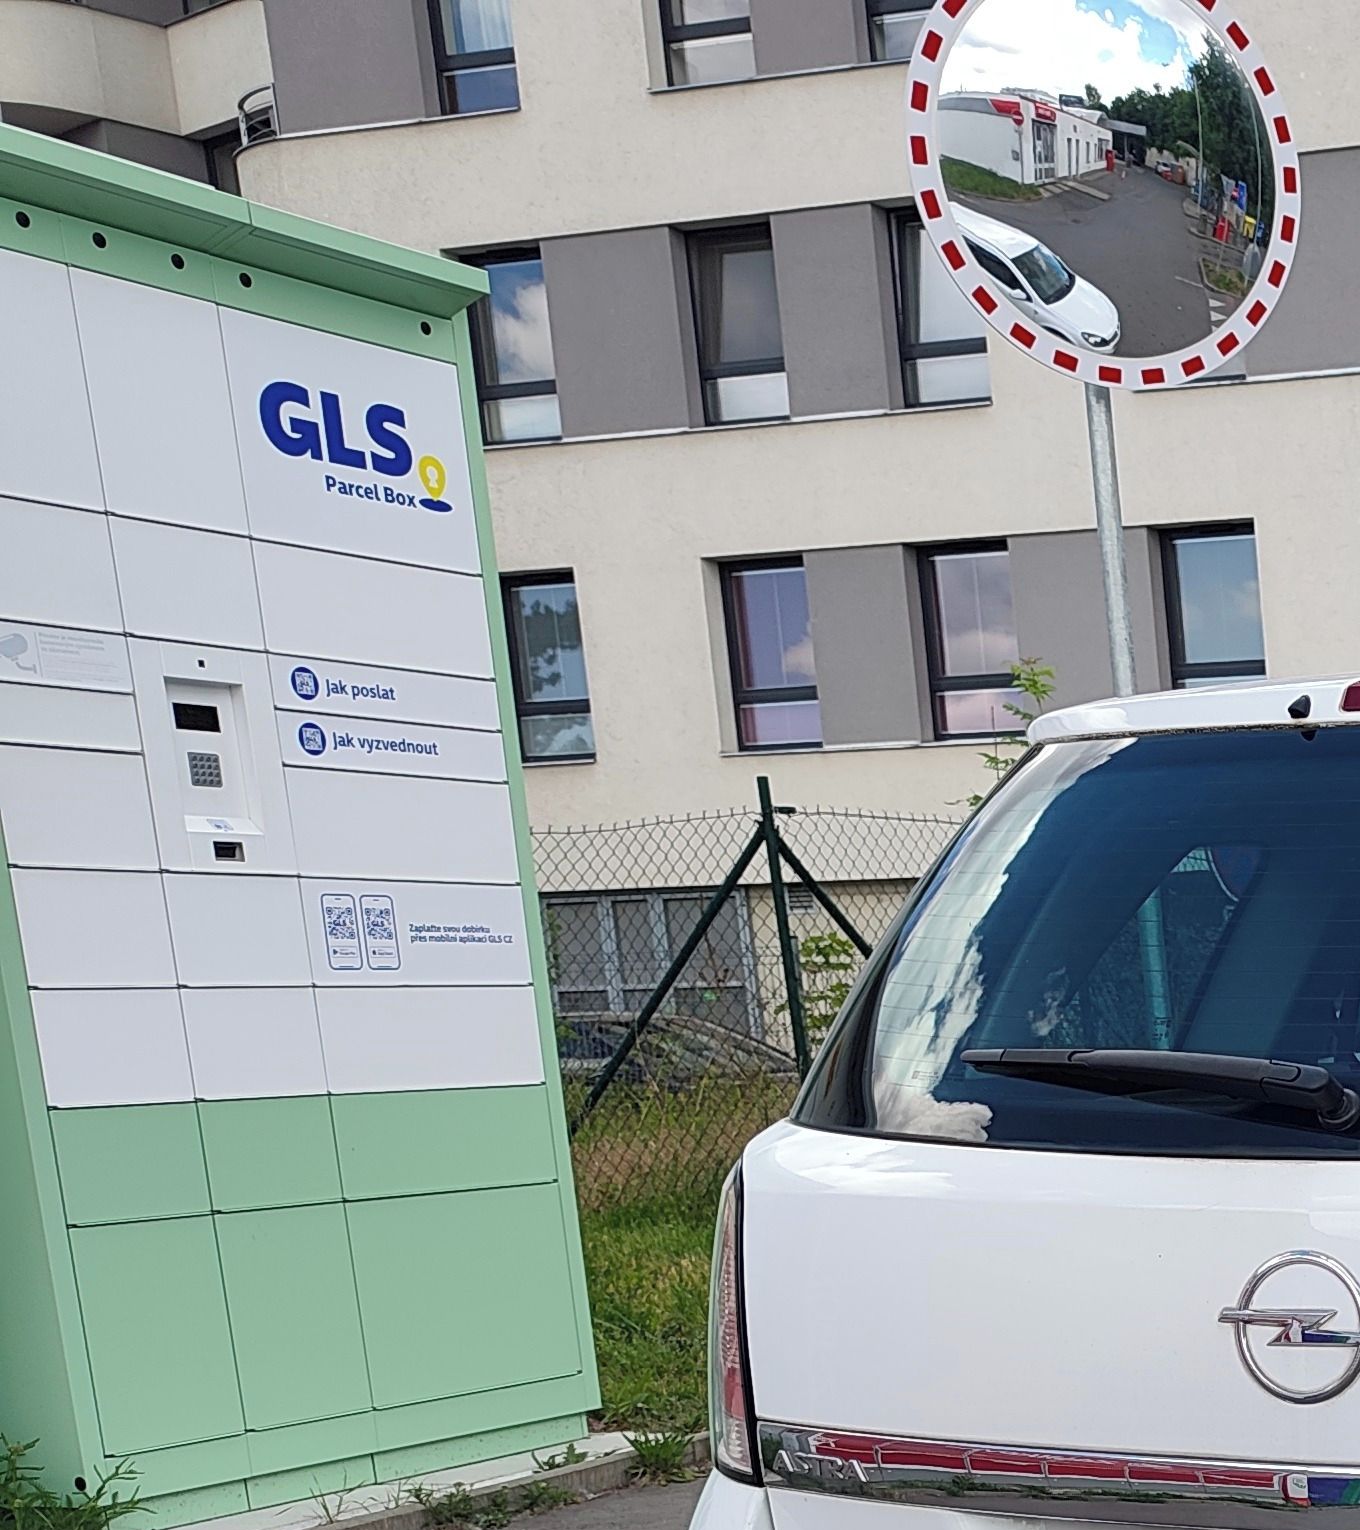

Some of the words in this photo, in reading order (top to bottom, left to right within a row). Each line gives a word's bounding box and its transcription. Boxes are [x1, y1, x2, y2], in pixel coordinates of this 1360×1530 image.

[259, 381, 413, 477] GLS
[325, 475, 381, 502] Parcel
[383, 486, 418, 509] Box
[325, 678, 349, 697] Jak
[351, 684, 396, 701] poslat
[332, 731, 355, 750] Jak
[357, 738, 440, 755] vyzvednout
[488, 935, 503, 944] GLS
[503, 935, 514, 944] CZ
[772, 1449, 870, 1483] ASTRA
